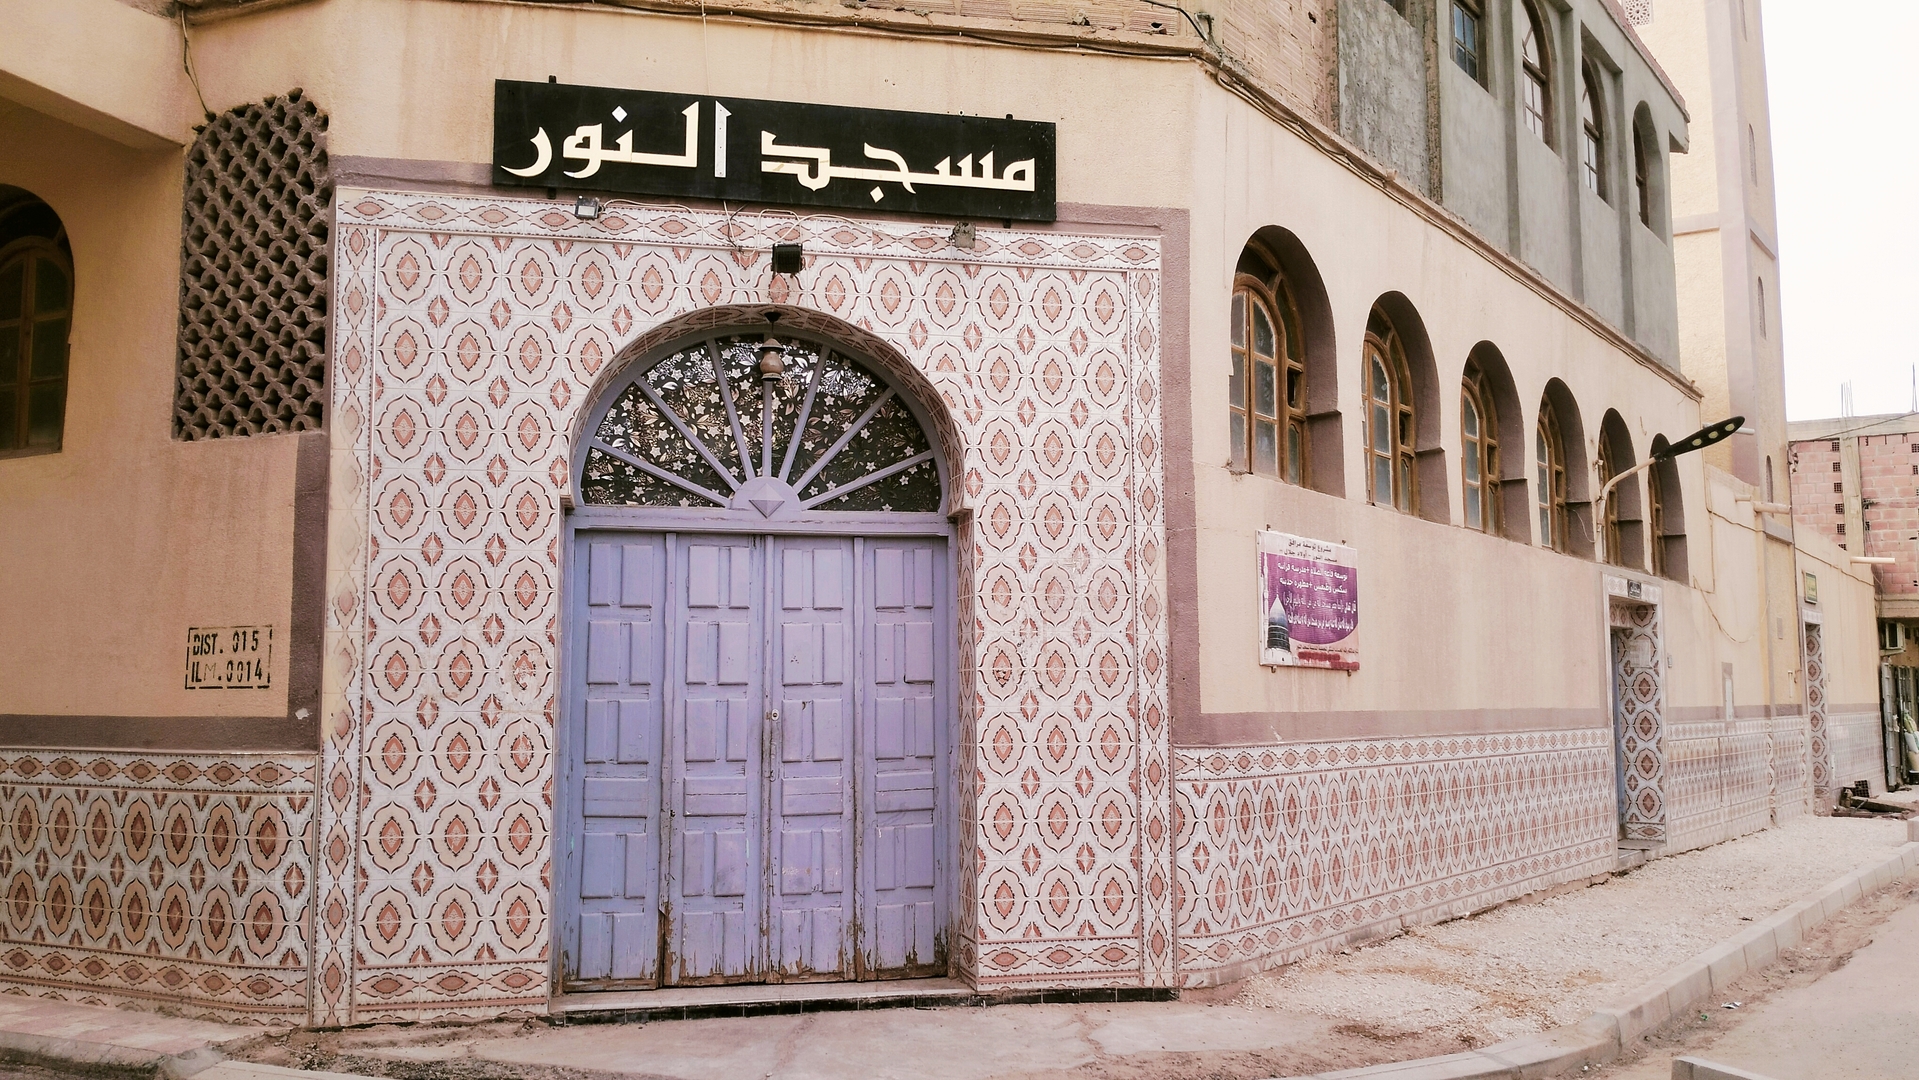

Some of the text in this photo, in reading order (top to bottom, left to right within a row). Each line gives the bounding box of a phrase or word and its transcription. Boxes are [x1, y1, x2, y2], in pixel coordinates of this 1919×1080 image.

[501, 100, 1036, 203] مسجد النور
[192, 630, 259, 655] DIST. 015
